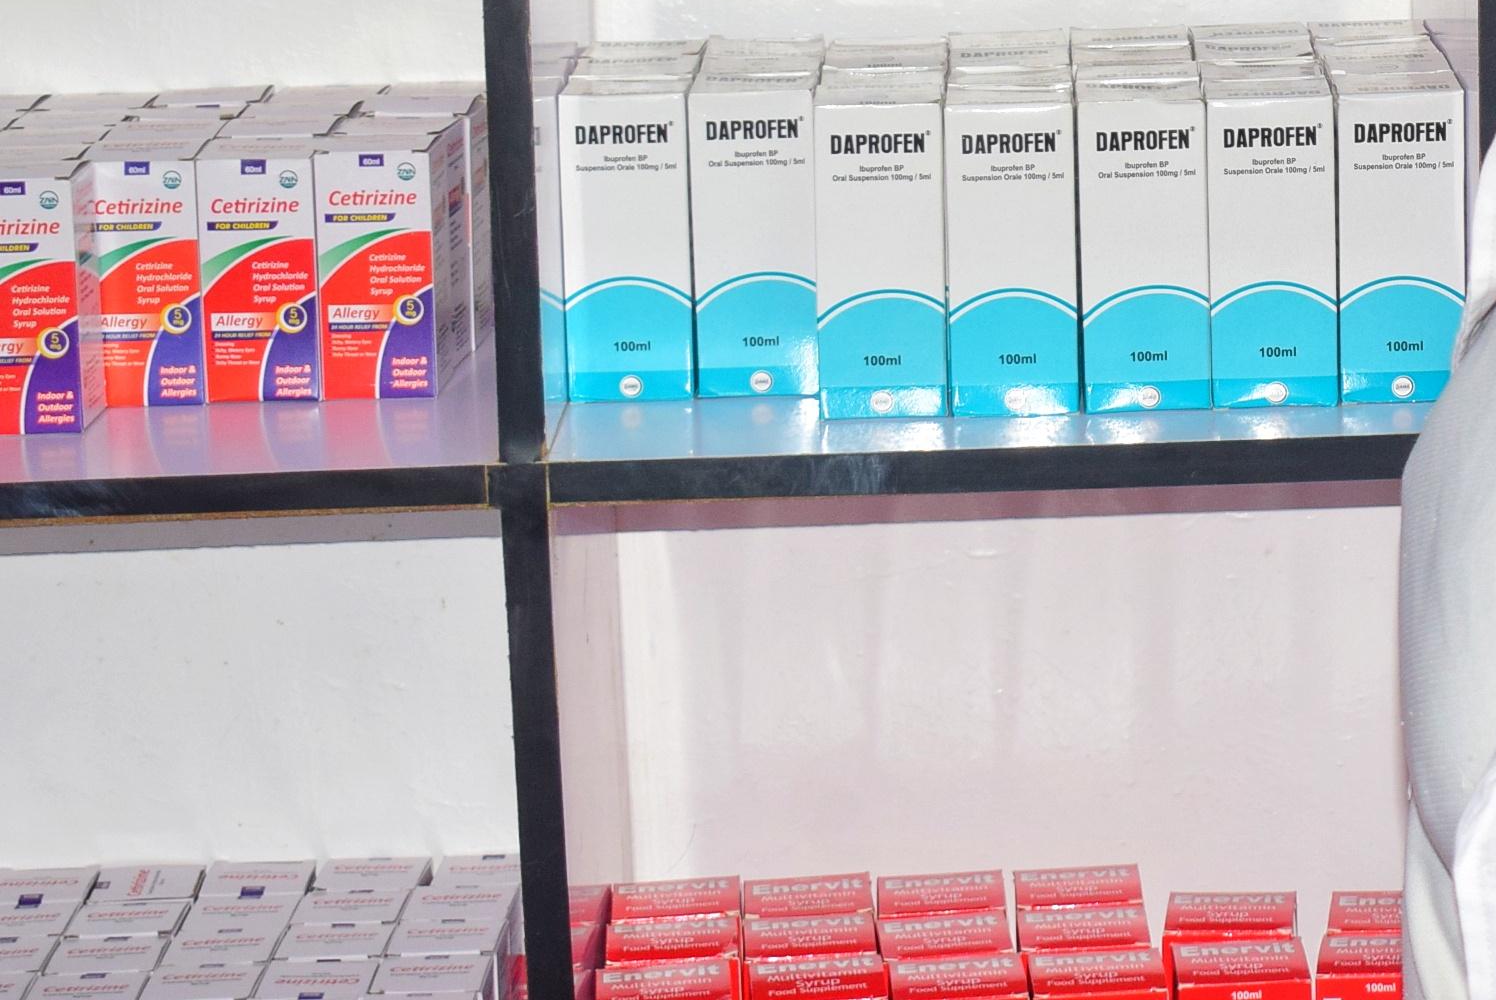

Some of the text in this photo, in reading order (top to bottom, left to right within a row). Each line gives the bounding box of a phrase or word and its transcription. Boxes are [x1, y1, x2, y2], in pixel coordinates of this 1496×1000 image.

[604, 155, 635, 163] Ibuprofen
[1125, 161, 1158, 169] Ibuprofen
[576, 164, 615, 172] Suspension
[637, 163, 658, 171] 100mg
[665, 162, 677, 170] 5ml
[859, 165, 892, 174] Ibuprofen
[1354, 163, 1393, 171] Suspension
[1415, 162, 1436, 170] 100mg
[849, 173, 889, 183] Suspension
[890, 173, 913, 182] 100mg
[1098, 171, 1112, 179] Oral
[1114, 170, 1154, 179] Suspension
[1156, 170, 1178, 178] 100mg
[329, 189, 417, 206] Cetirizine
[95, 198, 183, 215] Cetirizine
[211, 197, 300, 214] Cetirizine
[233, 222, 270, 230] CHILDREN
[252, 261, 289, 270] Cetirizine
[253, 272, 308, 281] Hydrochloride
[272, 283, 305, 291] Solution
[254, 295, 276, 304] Syrup
[333, 306, 380, 319] Allergy
[613, 340, 651, 353] 100ml
[742, 335, 780, 349] 100ml
[1386, 340, 1424, 353] 100ml
[998, 351, 1037, 366] 100ml
[1129, 350, 1168, 364] 100ml
[1259, 345, 1297, 359] 100ml
[863, 354, 902, 367] 100ml
[752, 878, 863, 895] Enervit
[884, 873, 994, 889] Enervit
[752, 915, 865, 931] Enervit
[884, 915, 998, 933] Enervit
[1180, 942, 1296, 957] Enervit
[757, 955, 875, 975] Enervit
[897, 957, 1014, 975] Enervit
[1035, 952, 1151, 967] Enervit
[603, 964, 720, 983] Enervit
[767, 968, 867, 982] Multivitamin
[768, 982, 867, 996] Food Supplement
[796, 978, 840, 988] Syrup
[1365, 983, 1396, 992] 100ml
[1231, 991, 1262, 1000] 100ml
